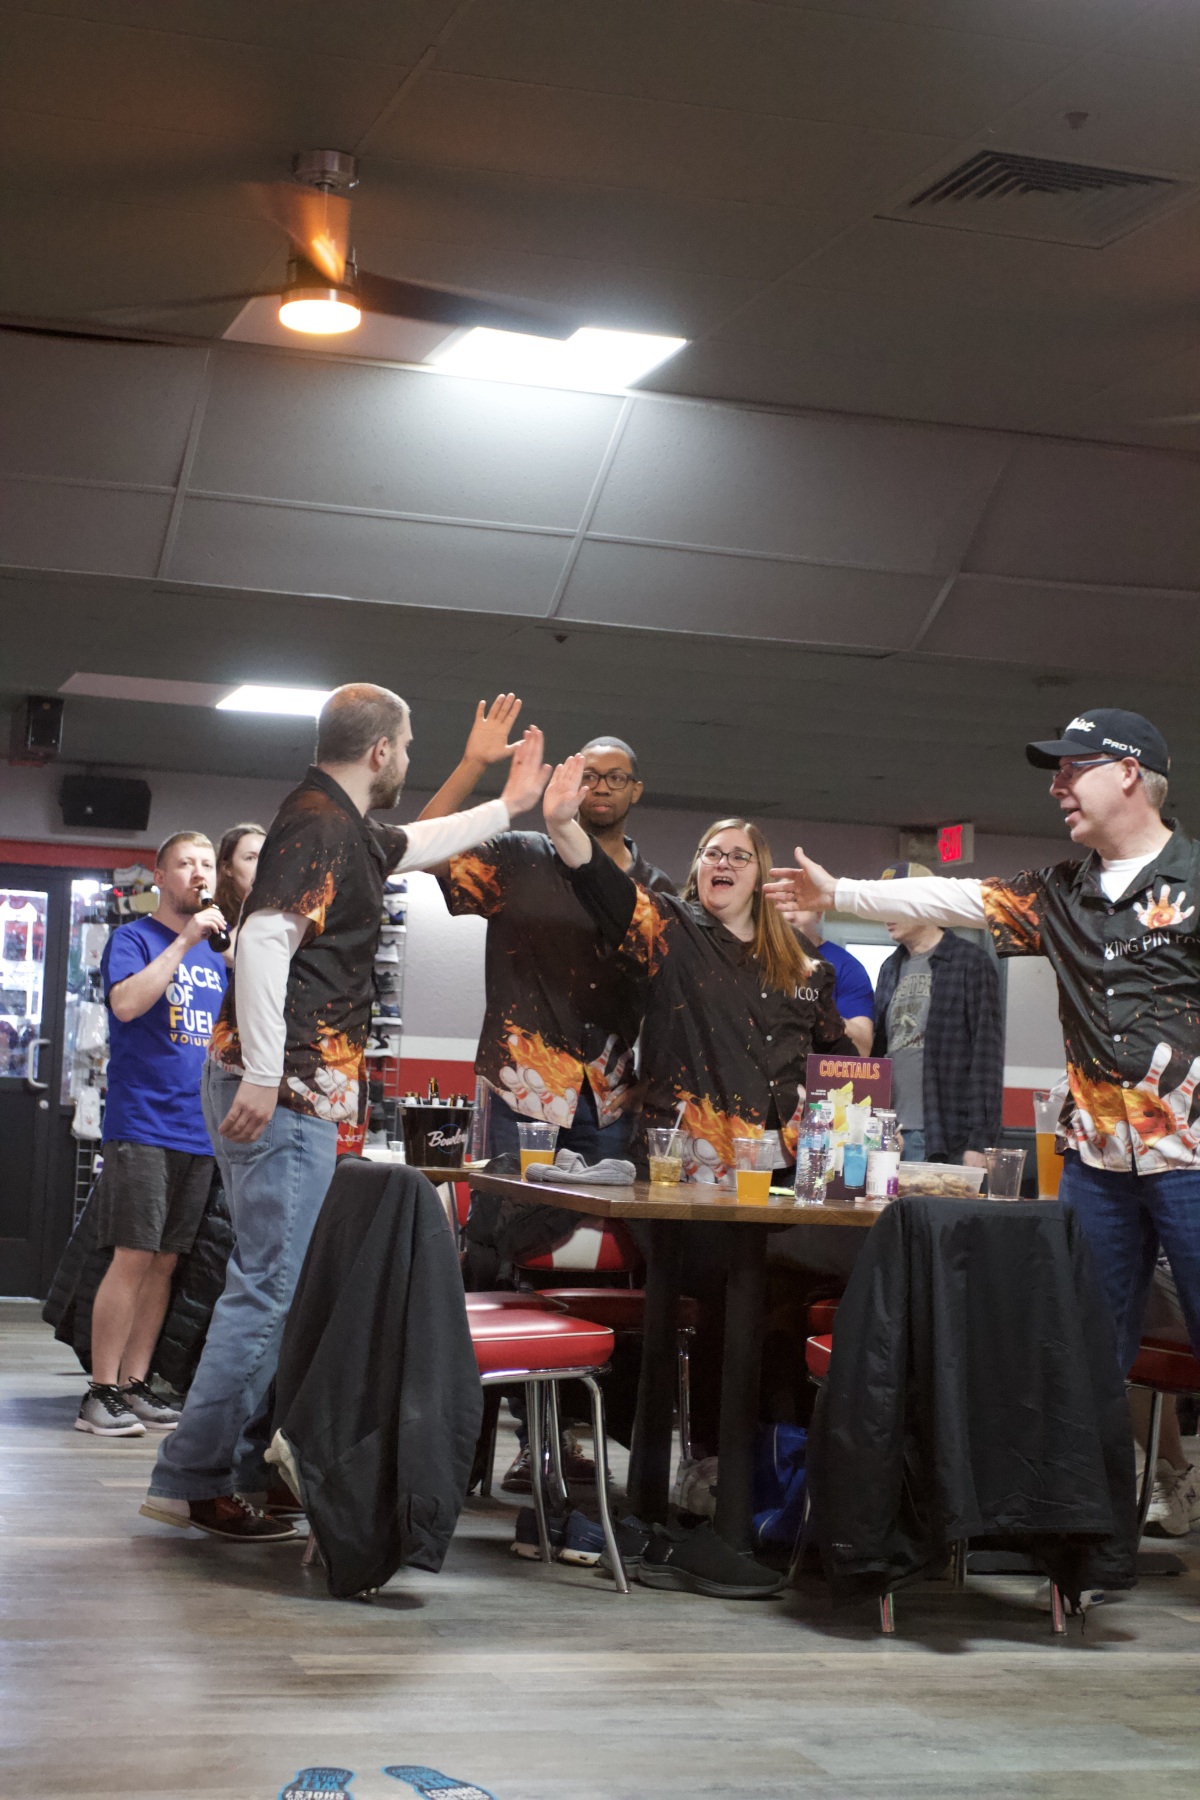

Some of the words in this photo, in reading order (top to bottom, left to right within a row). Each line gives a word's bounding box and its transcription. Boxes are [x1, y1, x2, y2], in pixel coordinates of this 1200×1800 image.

[941, 825, 963, 863] EXIT
[1105, 937, 1139, 960] KING
[1142, 932, 1171, 951] PIN
[172, 963, 222, 993] ACES
[165, 982, 194, 1008] OF
[819, 1060, 881, 1080] COCKTAILS
